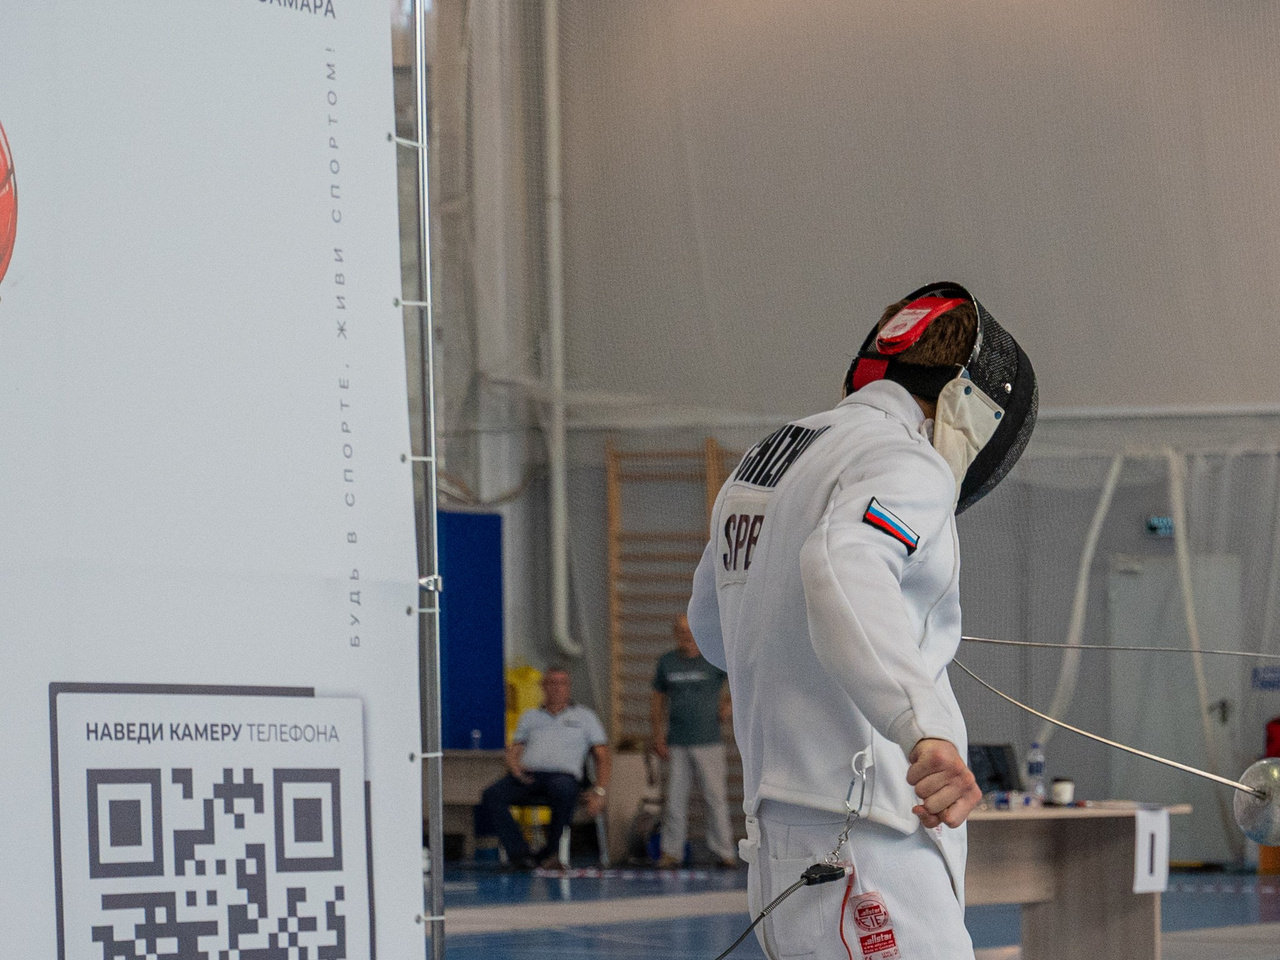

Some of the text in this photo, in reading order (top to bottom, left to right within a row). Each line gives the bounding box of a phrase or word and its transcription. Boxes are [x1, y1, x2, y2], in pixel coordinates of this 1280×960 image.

[258, 0, 336, 19] МАРА
[326, 47, 361, 647] БУДЬ В СПОРТЕ, ЖИВИ СПОРТОМ!
[86, 722, 340, 744] НАВЕДИ КАМЕРУ ТЕЛЕФОНА
